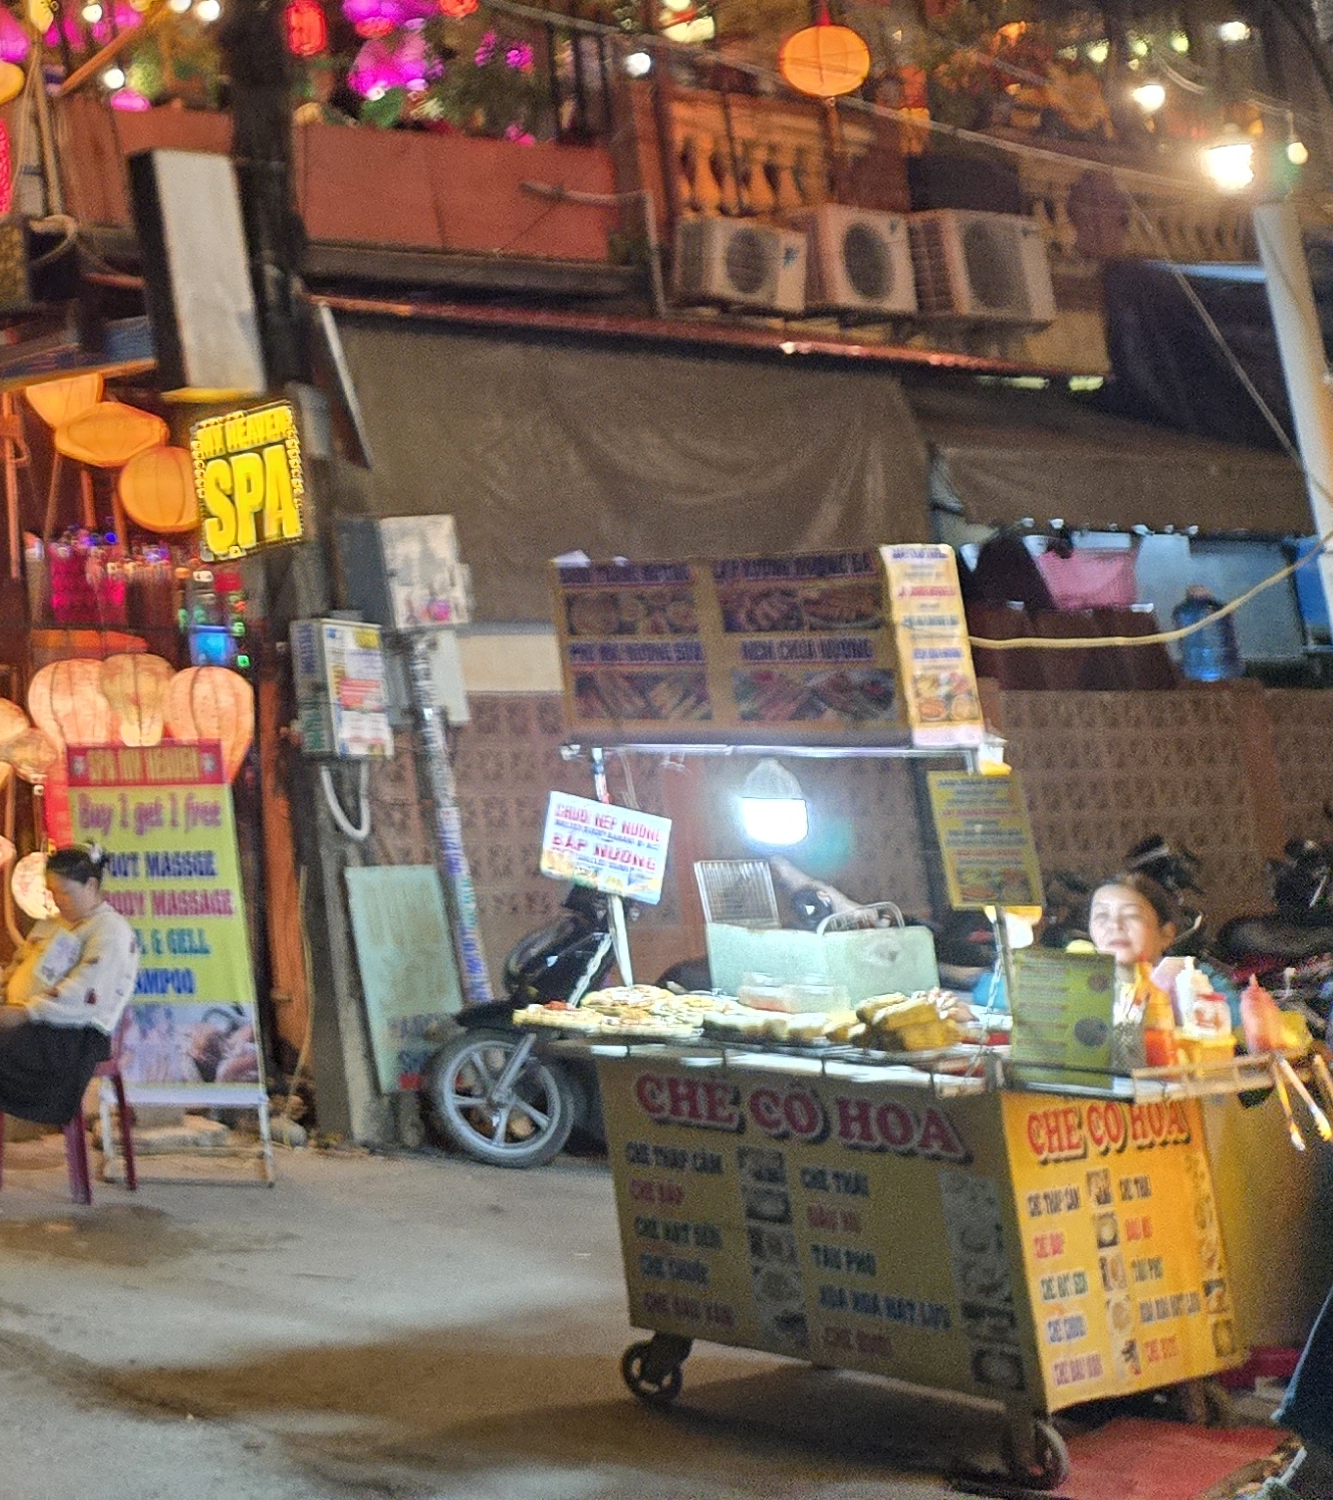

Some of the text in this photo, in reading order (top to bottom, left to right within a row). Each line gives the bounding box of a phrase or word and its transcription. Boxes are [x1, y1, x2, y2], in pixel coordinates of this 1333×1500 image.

[204, 444, 302, 555] SPA
[78, 791, 222, 837] Buy 1 get 1 free
[134, 967, 195, 994] AMPOO
[835, 1095, 974, 1163] HOA
